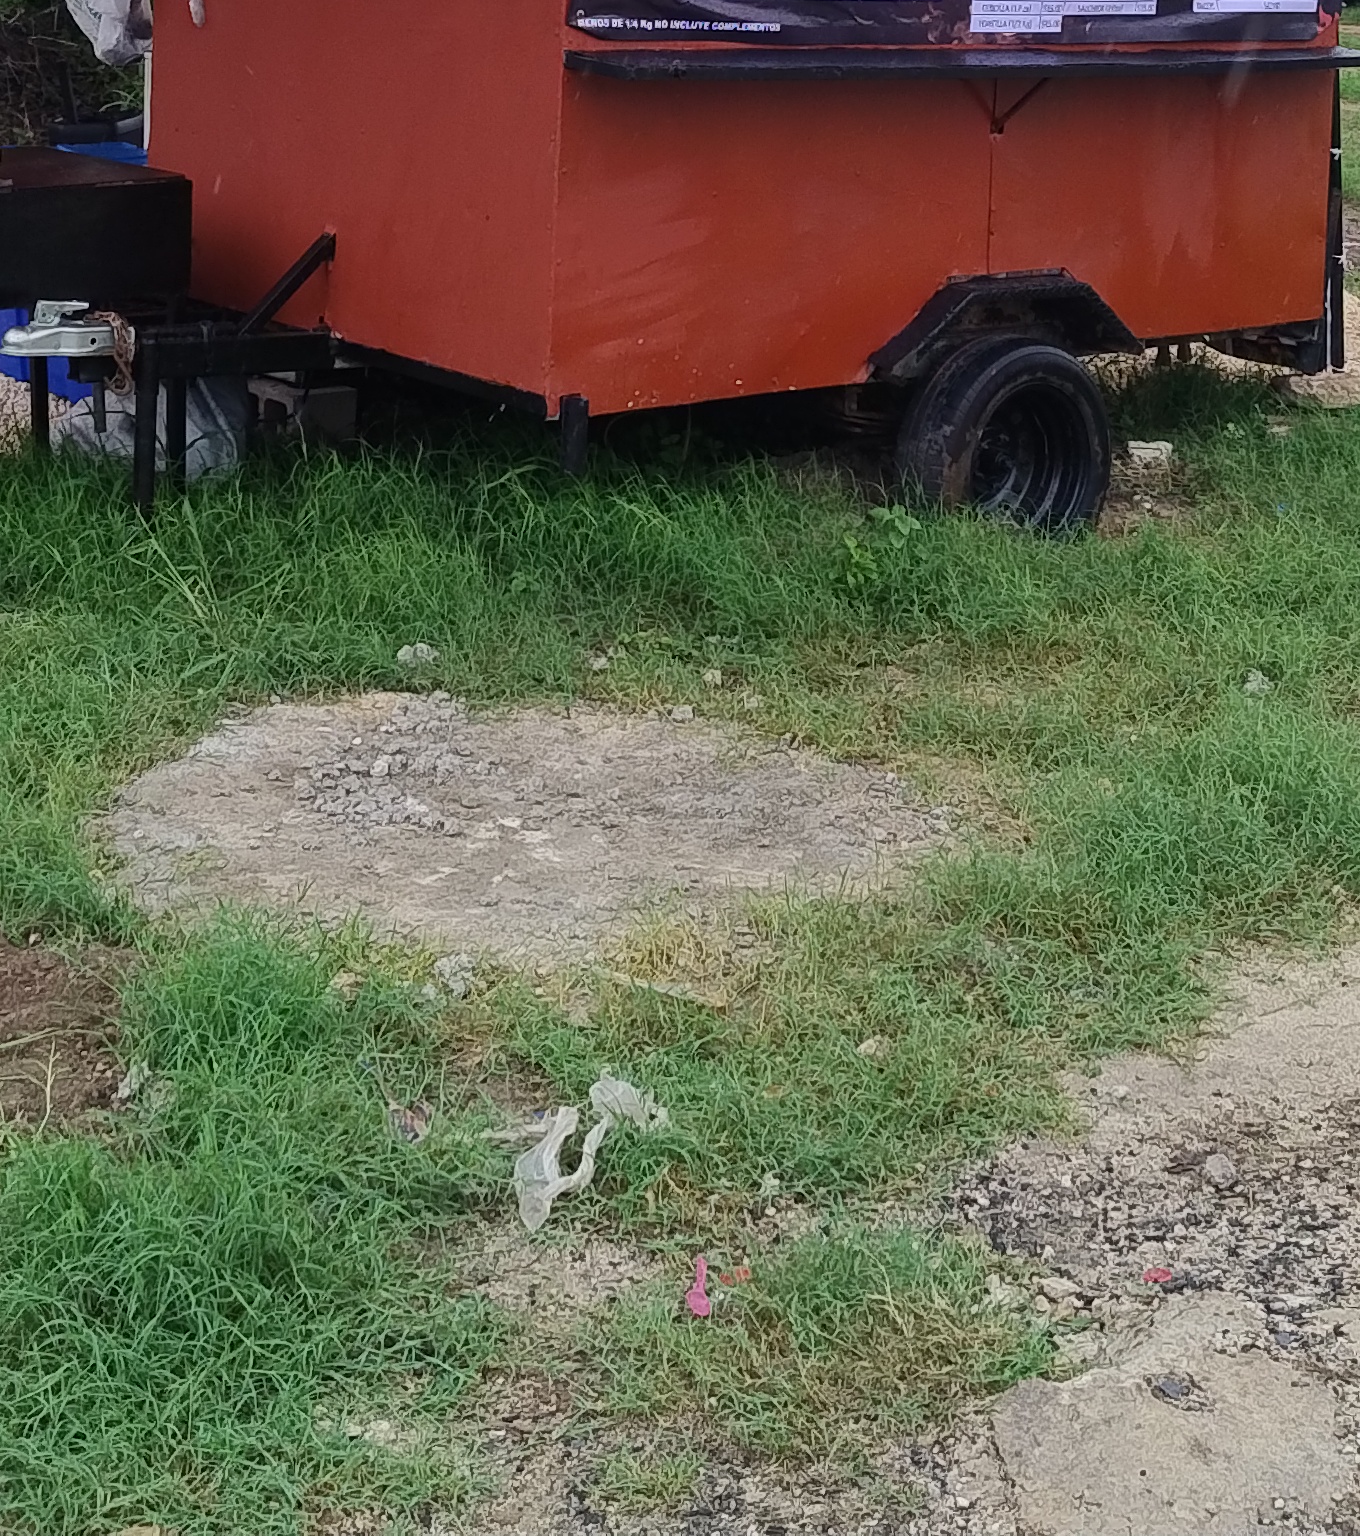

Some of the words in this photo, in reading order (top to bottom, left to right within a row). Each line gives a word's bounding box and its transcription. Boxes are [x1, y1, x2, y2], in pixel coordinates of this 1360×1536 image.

[612, 18, 624, 28] DE
[654, 20, 668, 29] NO
[712, 21, 780, 32] COMPLEMENTOS
